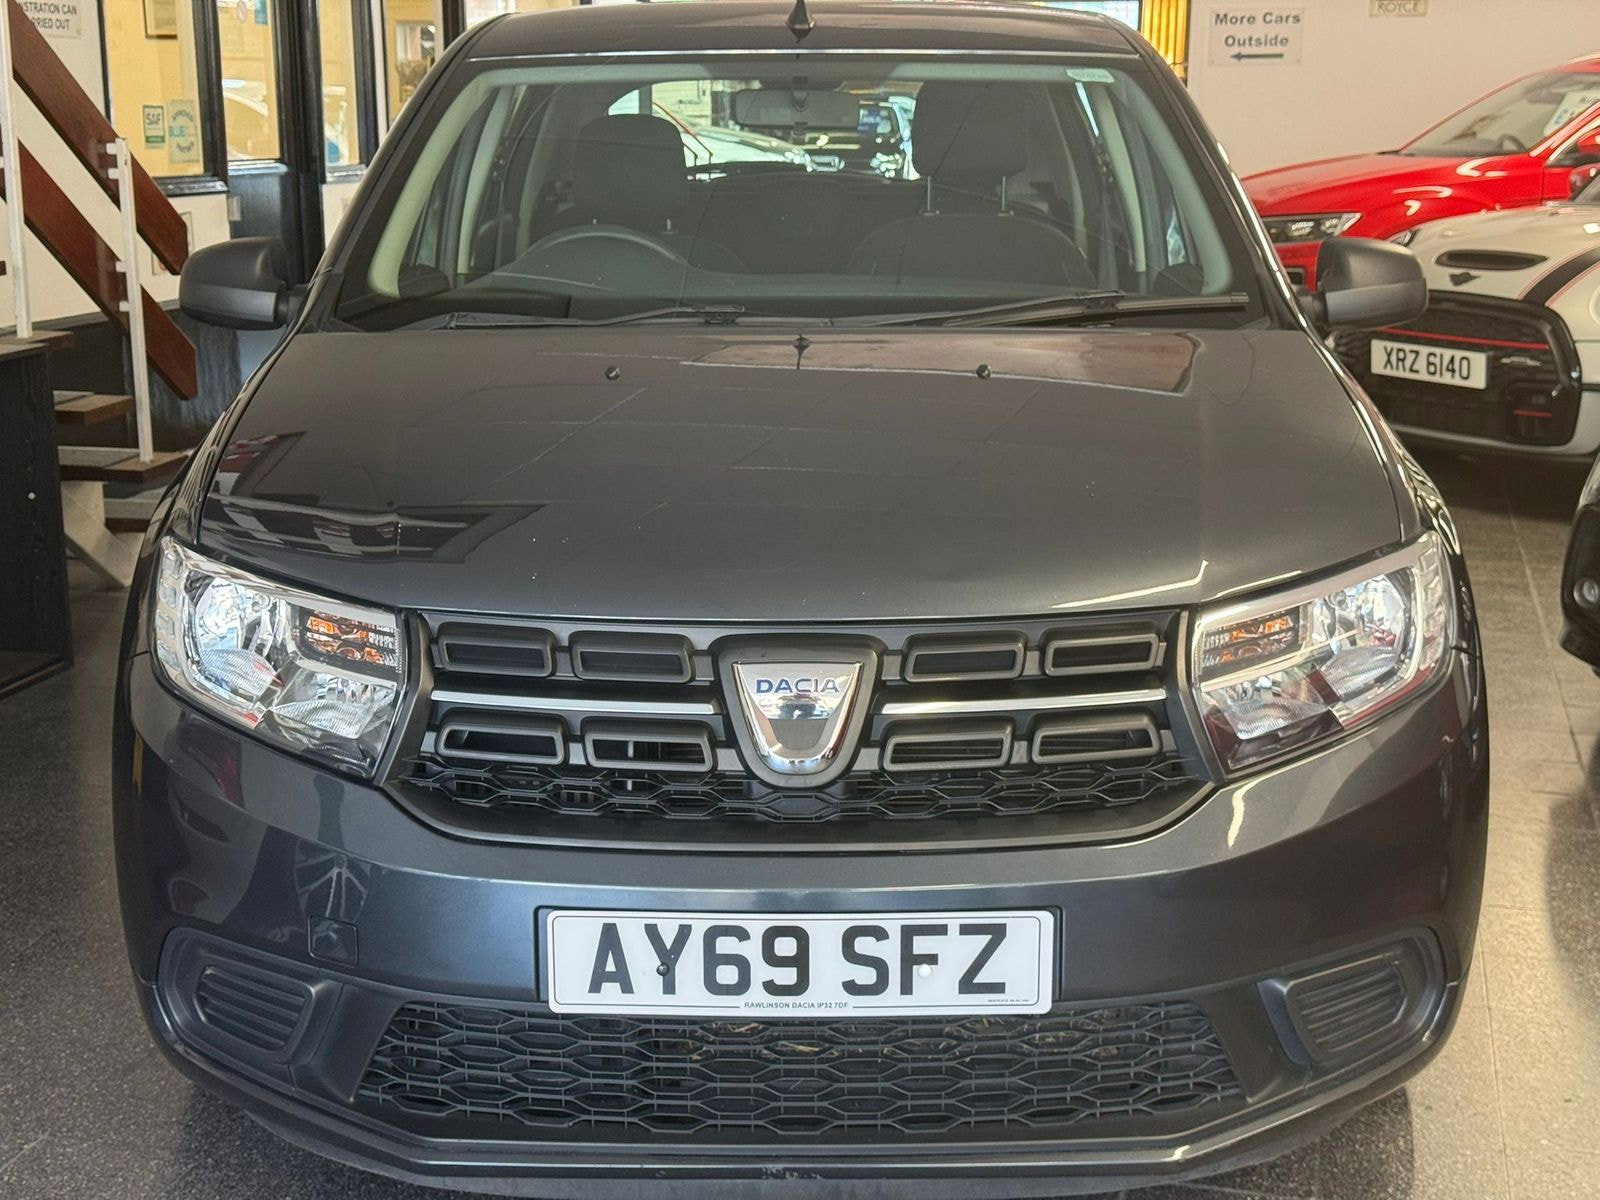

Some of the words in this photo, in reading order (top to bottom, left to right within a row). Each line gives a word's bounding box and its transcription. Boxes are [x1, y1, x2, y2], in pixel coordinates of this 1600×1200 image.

[19, 2, 60, 14] STRATION
[61, 4, 77, 15] CAN
[31, 17, 53, 29] RRIED
[55, 18, 70, 30] OUT
[1214, 13, 1256, 25] More
[1262, 12, 1301, 25] Cars
[1224, 35, 1289, 48] Outside
[1383, 346, 1420, 374] XRZ
[1426, 352, 1471, 380] 6140
[756, 678, 840, 693] DACIA
[587, 922, 810, 997] AY69
[841, 923, 1007, 997] SFZ
[744, 1001, 790, 1009] RAWLINSON
[791, 1001, 815, 1009] DACIA
